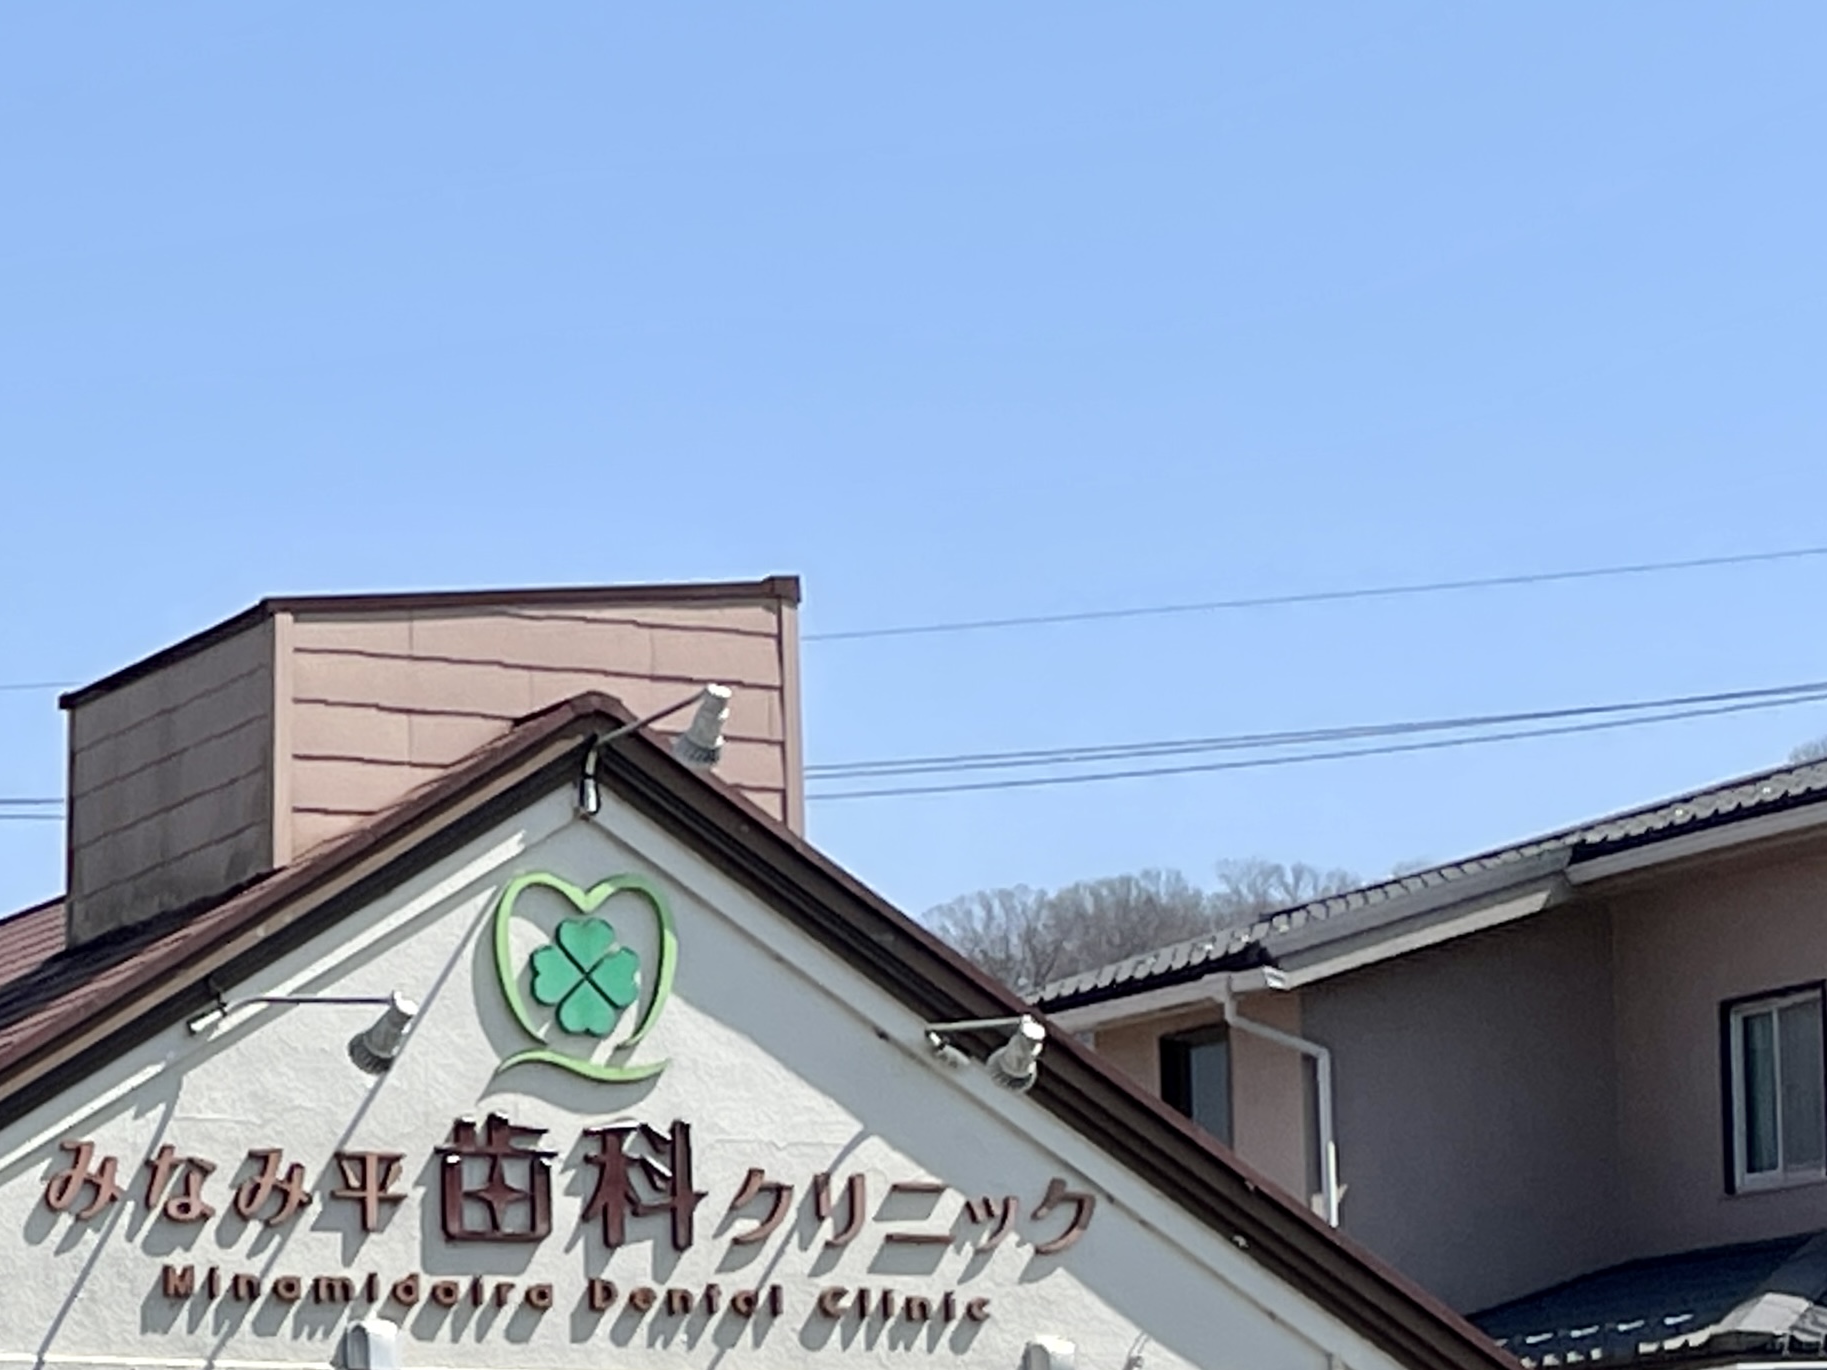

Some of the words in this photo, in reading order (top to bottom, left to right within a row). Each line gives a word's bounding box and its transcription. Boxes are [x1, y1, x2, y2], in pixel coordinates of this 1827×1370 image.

[45, 1111, 1096, 1255] みなみ平歯科クリニック
[161, 1264, 554, 1311] Minamidaira
[587, 1276, 784, 1317] Dental
[817, 1285, 992, 1322] Clinic
